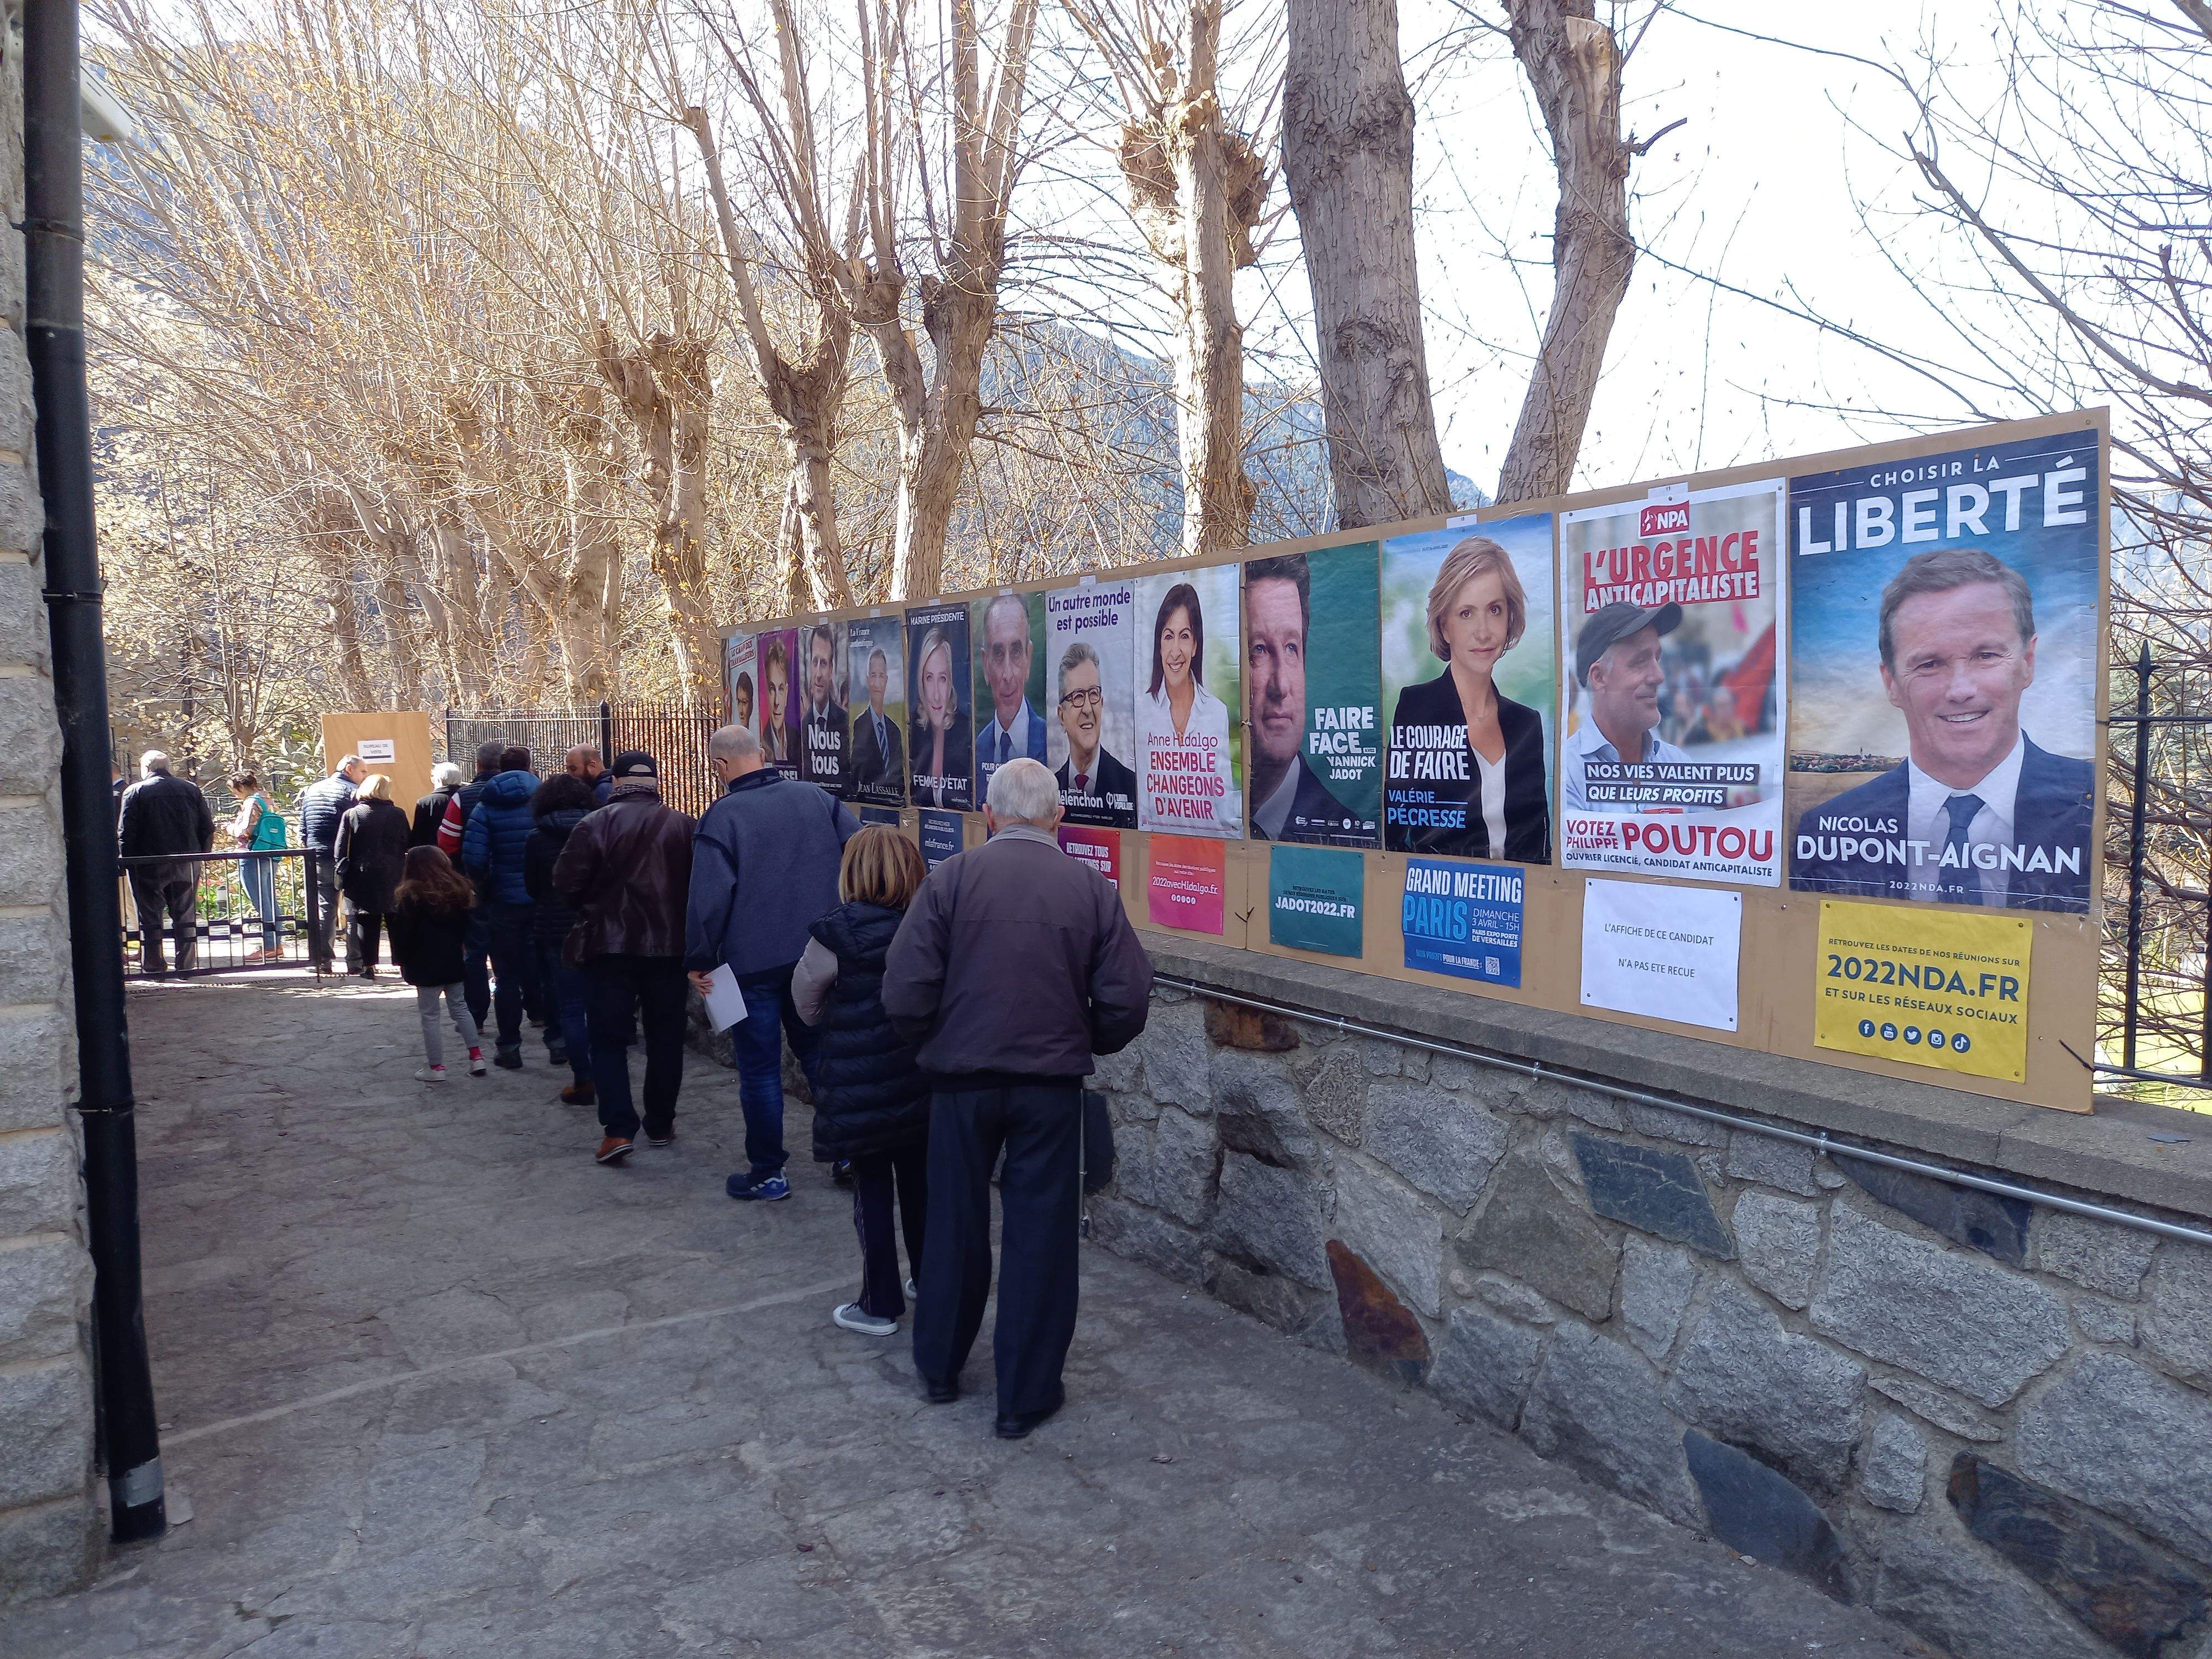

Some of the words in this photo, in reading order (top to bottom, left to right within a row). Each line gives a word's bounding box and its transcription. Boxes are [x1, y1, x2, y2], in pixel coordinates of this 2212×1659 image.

[1870, 462, 1962, 488] CHOISIR
[1973, 456, 2000, 472] LA
[1799, 455, 2087, 556] LIBERTÉ
[1657, 509, 1689, 529] NPA
[1584, 530, 1759, 586] L'URGENCE
[1049, 596, 1060, 612] Un
[1063, 594, 1091, 611] autre
[1093, 586, 1130, 607] monde
[1586, 571, 1757, 612] ANTICAPITALISTE
[910, 615, 930, 625] MARINE
[1057, 615, 1072, 631] est
[1075, 608, 1118, 634] possible
[1314, 706, 1374, 730] FAIRE
[808, 723, 841, 750] Nous
[1147, 732, 1170, 746] Anne
[1173, 732, 1218, 751] Hidalgo
[1310, 732, 1361, 754] FACE
[1390, 725, 1404, 749] LE
[1406, 723, 1468, 749] COURAGE
[811, 751, 839, 775] tous
[1151, 751, 1215, 772] ENSEMBLE
[1326, 755, 1376, 768] YANNICK
[1390, 751, 1411, 779] DE
[1413, 751, 1470, 780] FAIRE
[1587, 765, 1620, 778] NOS
[1624, 765, 1655, 779] VIES
[1657, 765, 1714, 781] VALENT
[1717, 766, 1755, 781] PLUS
[913, 775, 938, 789] FEMME
[1147, 774, 1224, 797] CHANGEONS
[1329, 769, 1362, 780] JADOT
[1388, 788, 1435, 804] VALÉRIE
[1588, 786, 1616, 801] QUE
[1620, 787, 1659, 802] LEURS
[1662, 788, 1724, 804] PROFITS
[1155, 797, 1214, 820] D'AVENIR
[1387, 803, 1466, 828] PÉCRESSE
[1567, 820, 1616, 836] VOTEZ
[1819, 816, 1898, 834] NICOLAS
[1094, 846, 1109, 858] TOUS
[1566, 836, 1618, 849] PHILIPPE
[1621, 822, 1773, 862] POUTOU
[1566, 853, 1601, 862] OUVRIER
[1644, 858, 1691, 870] CANDIDAT
[1693, 862, 1772, 877] ANTICAPITALISTE
[1797, 835, 2081, 875] DUPONT-AIGNAN
[1406, 867, 1451, 895] GRAND
[1454, 872, 1521, 903] MEETING
[1889, 880, 1964, 894] 2022NDA.FR
[1275, 896, 1355, 919] JADOT2022.FR
[1403, 895, 1467, 940] PARIS
[1473, 908, 1519, 922] DIMANCHE
[1478, 919, 1498, 928] AVRIL
[1505, 922, 1520, 931] 15H
[1605, 923, 1643, 937] L'AFFICHE
[1645, 929, 1655, 938] DE
[1656, 930, 1667, 939] CE
[1670, 932, 1714, 945] CANDIDAT
[1481, 937, 1517, 948] VERSAILLES
[1828, 938, 1874, 950] RETROUVEZ
[1876, 943, 1890, 952] LES
[1892, 945, 1917, 955] DATES
[1933, 950, 1950, 959] NOS
[1953, 951, 1999, 964] RÉUNIONS
[2002, 958, 2020, 967] SUR
[1619, 958, 1633, 968] N'A
[1635, 961, 1649, 971] PAS
[1651, 963, 1666, 973] ETE
[1668, 966, 1695, 977] RECUE
[1827, 954, 2019, 1002] 2022NDA.FR
[1825, 987, 1839, 998] ET
[1842, 990, 1865, 1002] SUR
[1869, 994, 1890, 1006] LES
[1894, 995, 1952, 1015] RÉSEAUX
[1957, 1006, 2018, 1025] SOCIAUX
